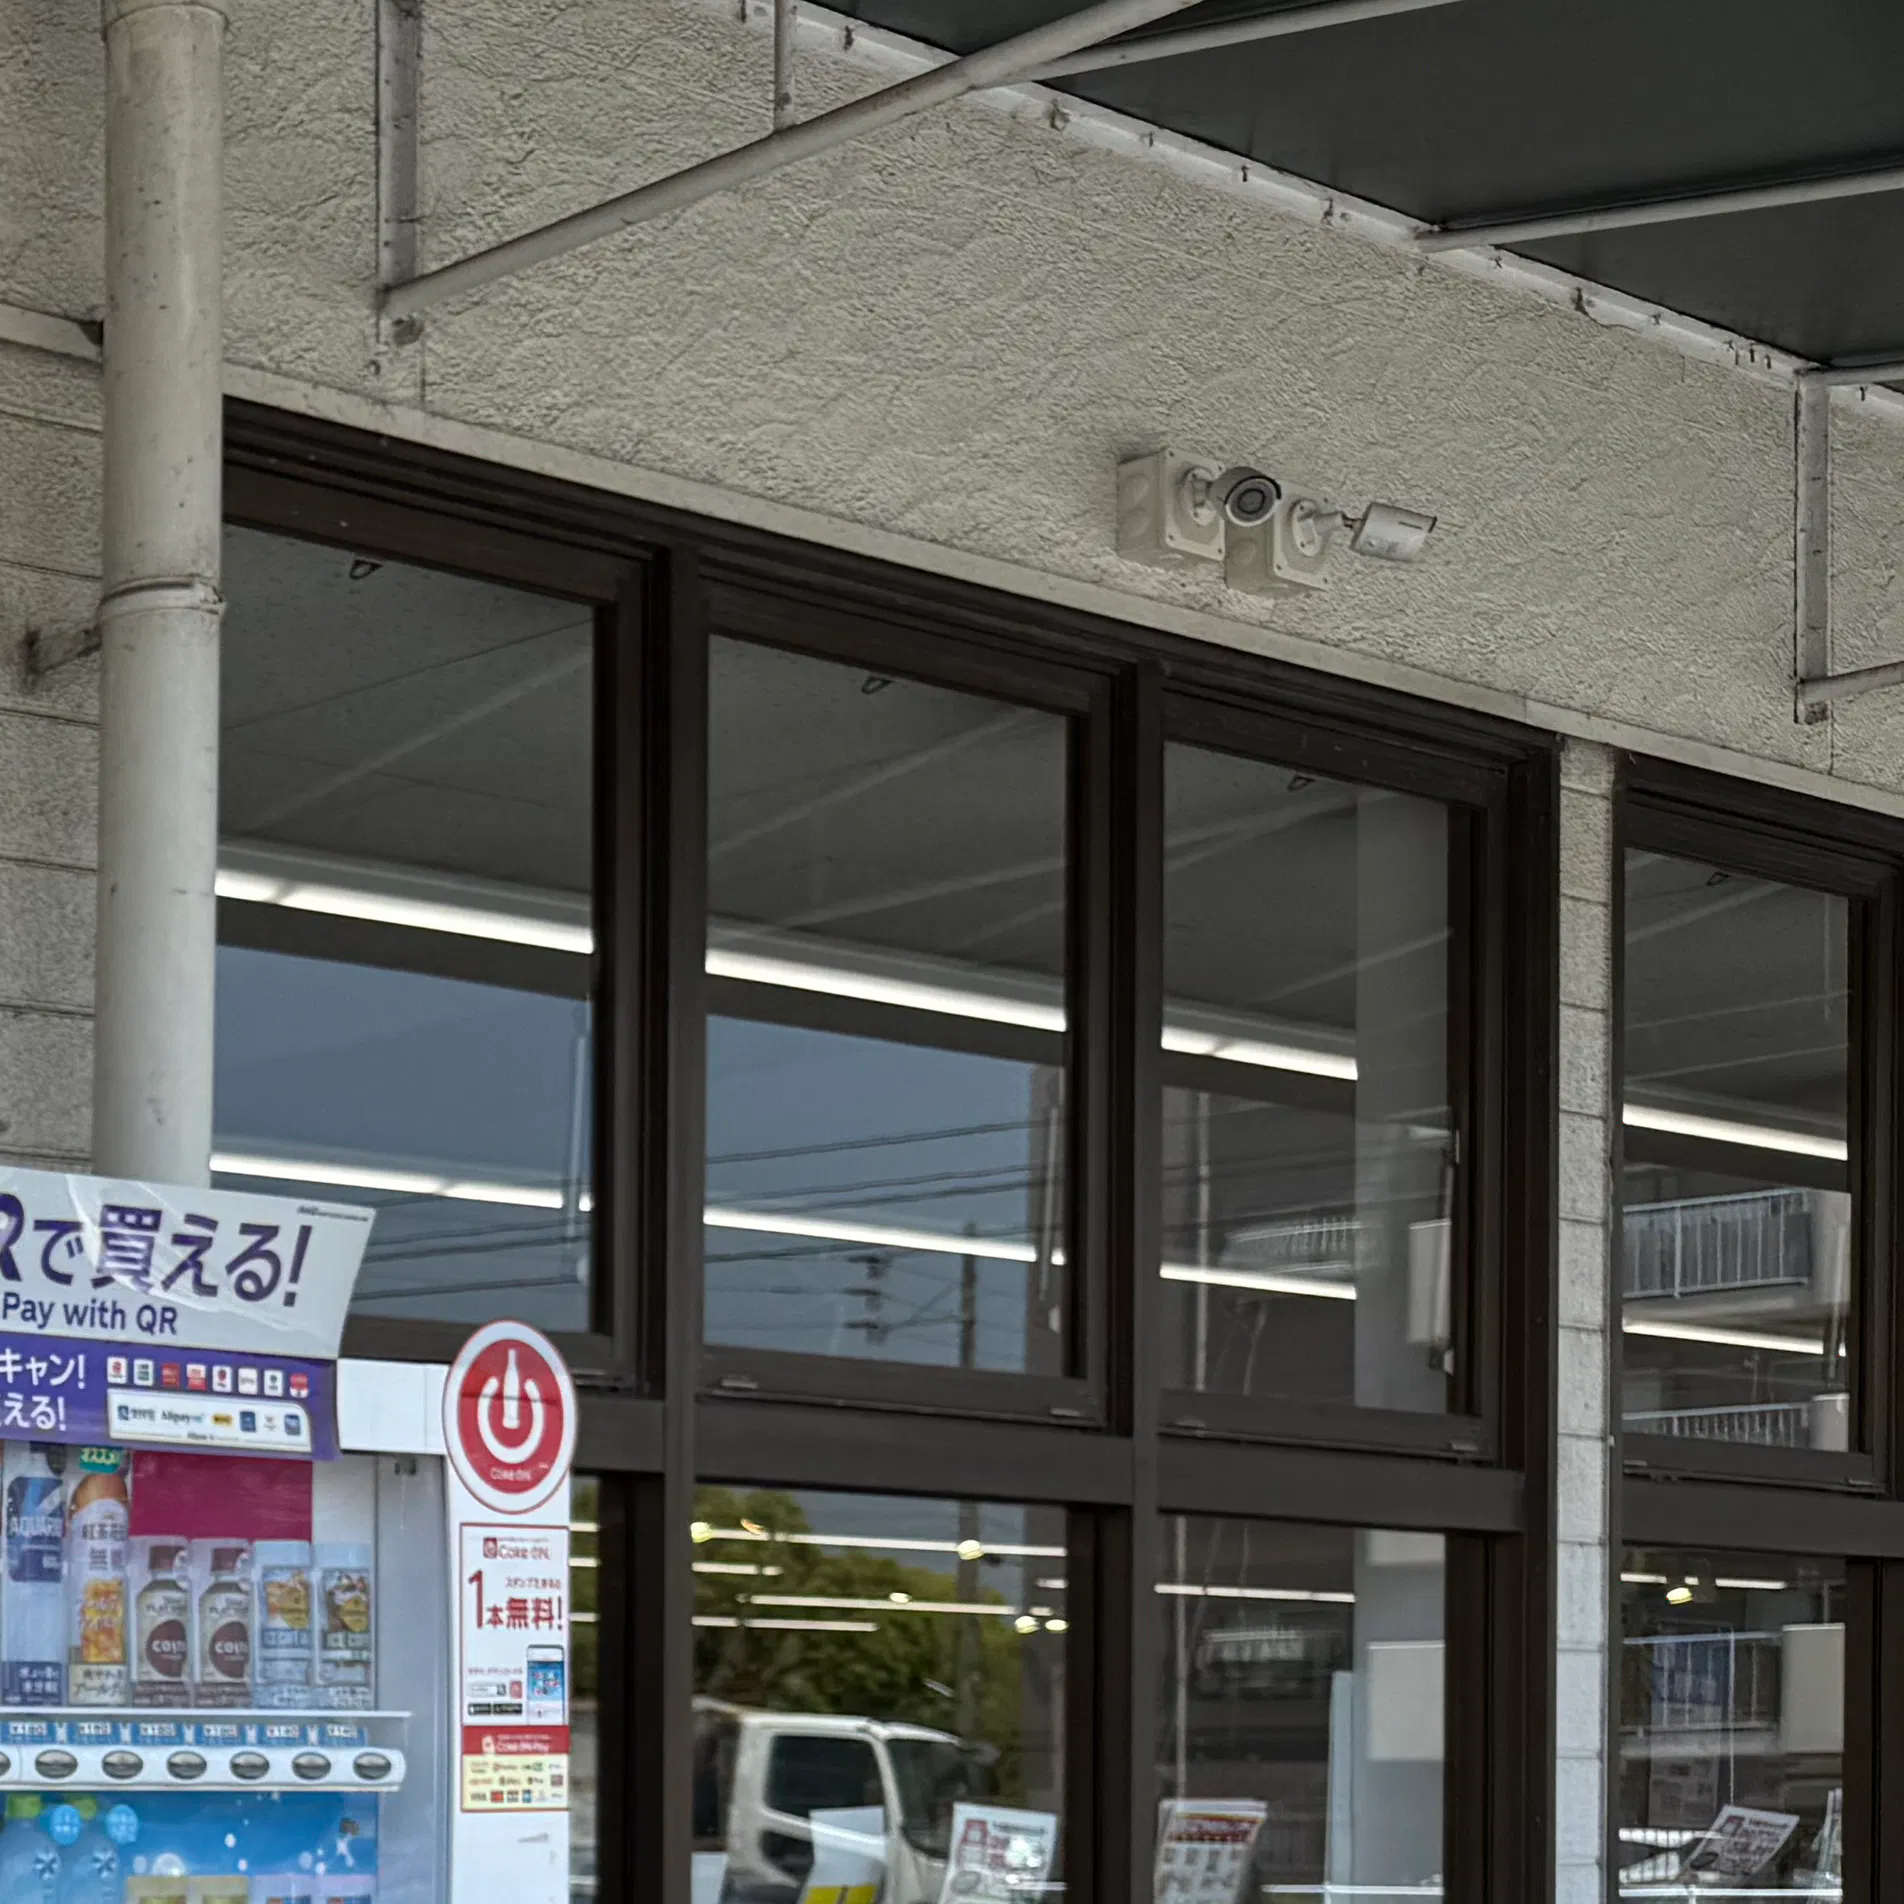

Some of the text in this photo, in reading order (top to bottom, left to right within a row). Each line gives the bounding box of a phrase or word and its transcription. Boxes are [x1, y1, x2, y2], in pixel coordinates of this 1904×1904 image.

[1, 1291, 178, 1335] Pay with QR
